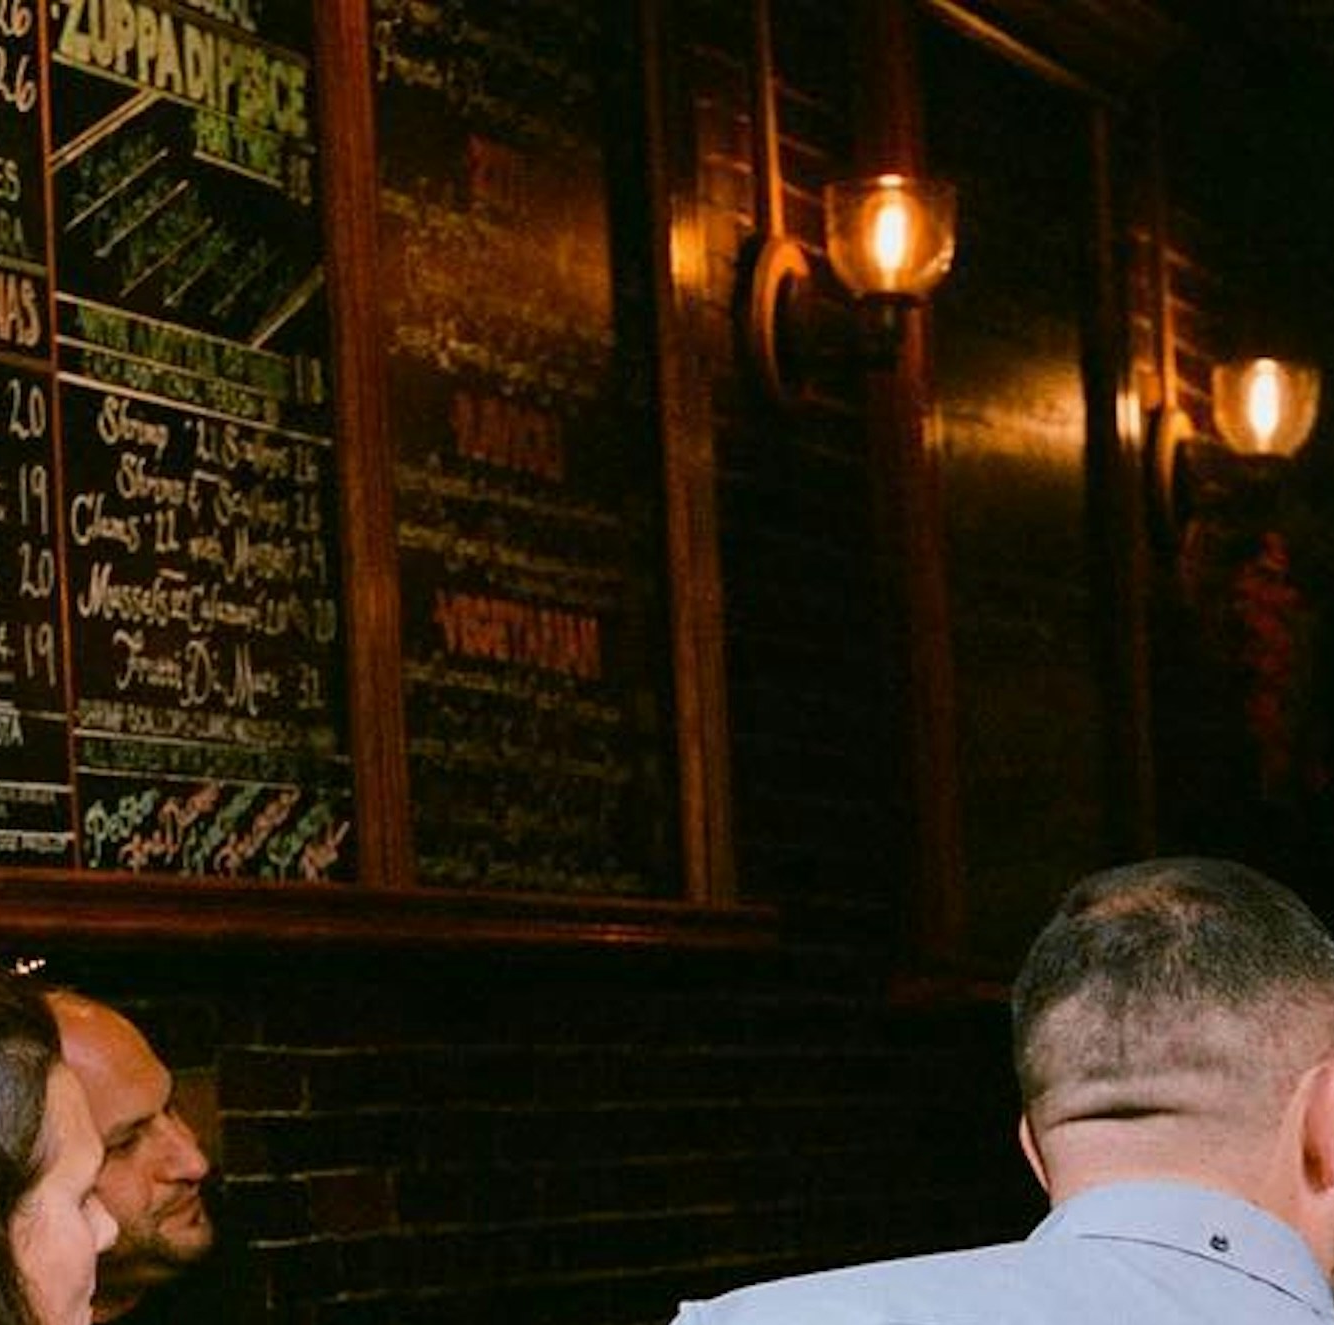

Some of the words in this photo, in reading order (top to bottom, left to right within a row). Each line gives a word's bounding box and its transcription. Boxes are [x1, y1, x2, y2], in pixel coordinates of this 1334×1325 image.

[6, 378, 48, 441] 20
[17, 463, 49, 536] 19
[18, 540, 55, 600] 20
[22, 620, 59, 687] 19
